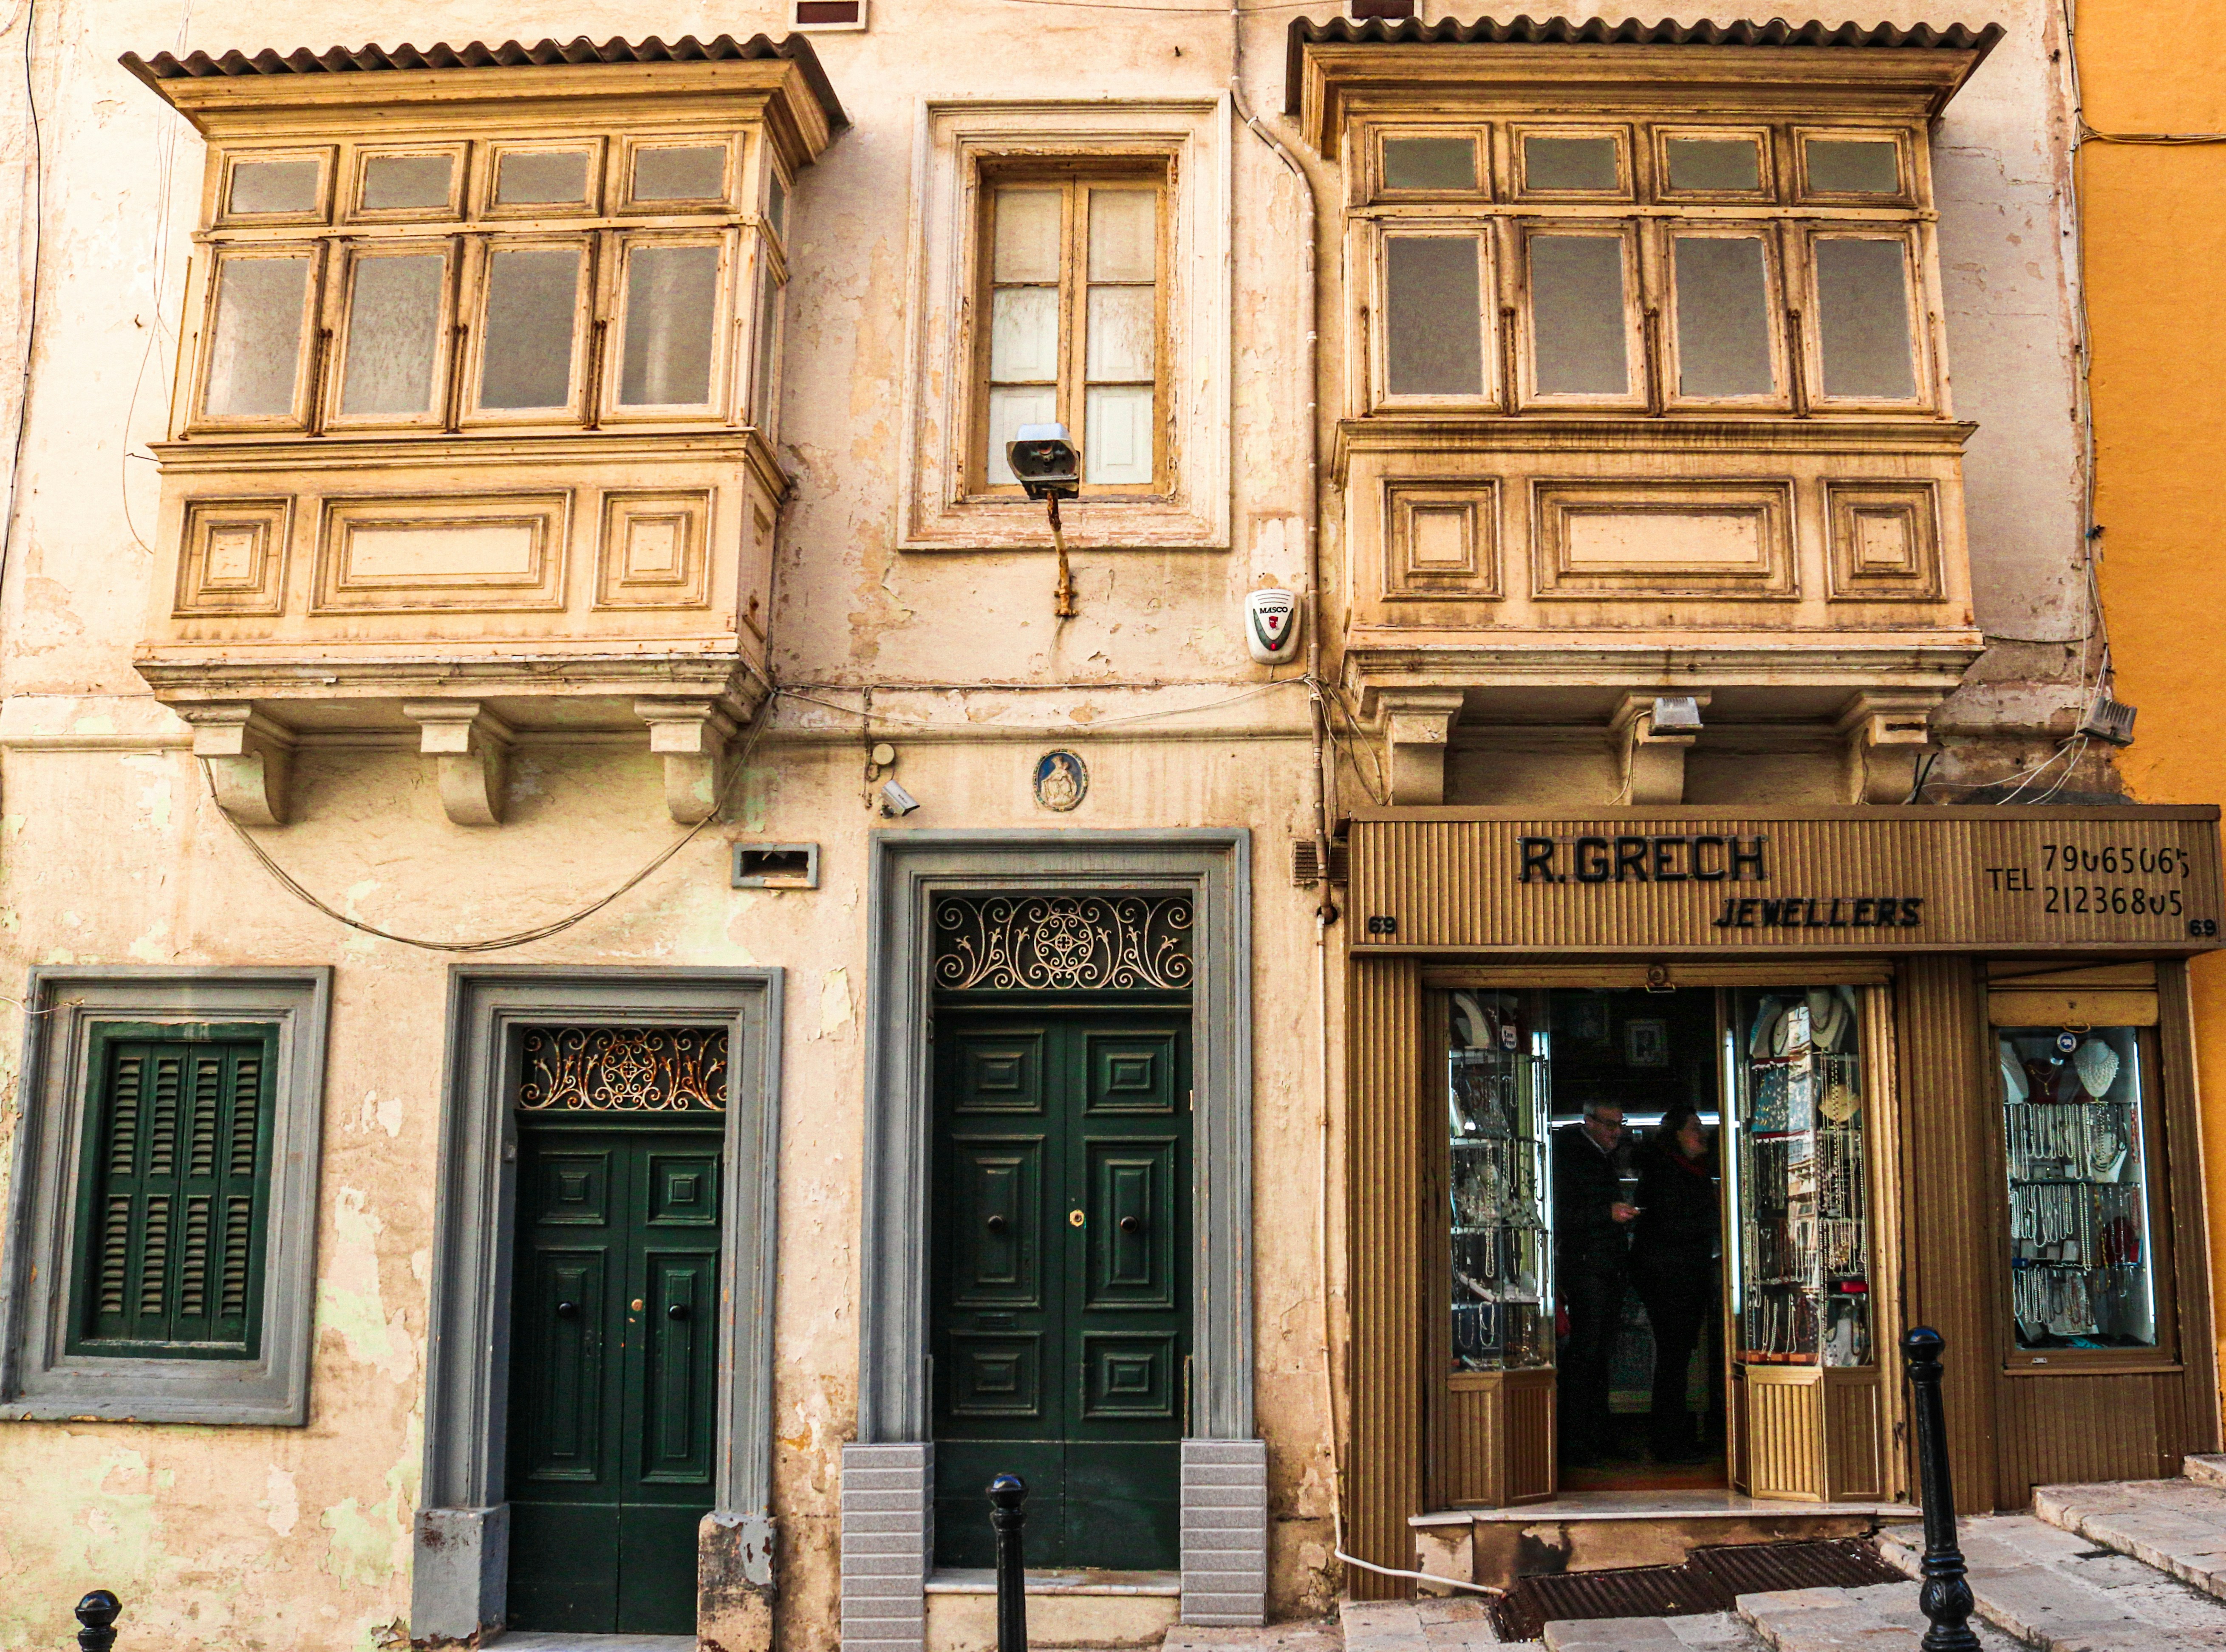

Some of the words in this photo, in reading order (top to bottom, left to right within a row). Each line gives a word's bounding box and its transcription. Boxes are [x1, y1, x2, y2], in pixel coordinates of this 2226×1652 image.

[1986, 868, 2034, 891] TEL
[1713, 898, 1922, 927] JEWELLERS
[2045, 886, 2183, 916] 21236805
[1368, 916, 1396, 934] 69
[2189, 919, 2217, 935] 69
